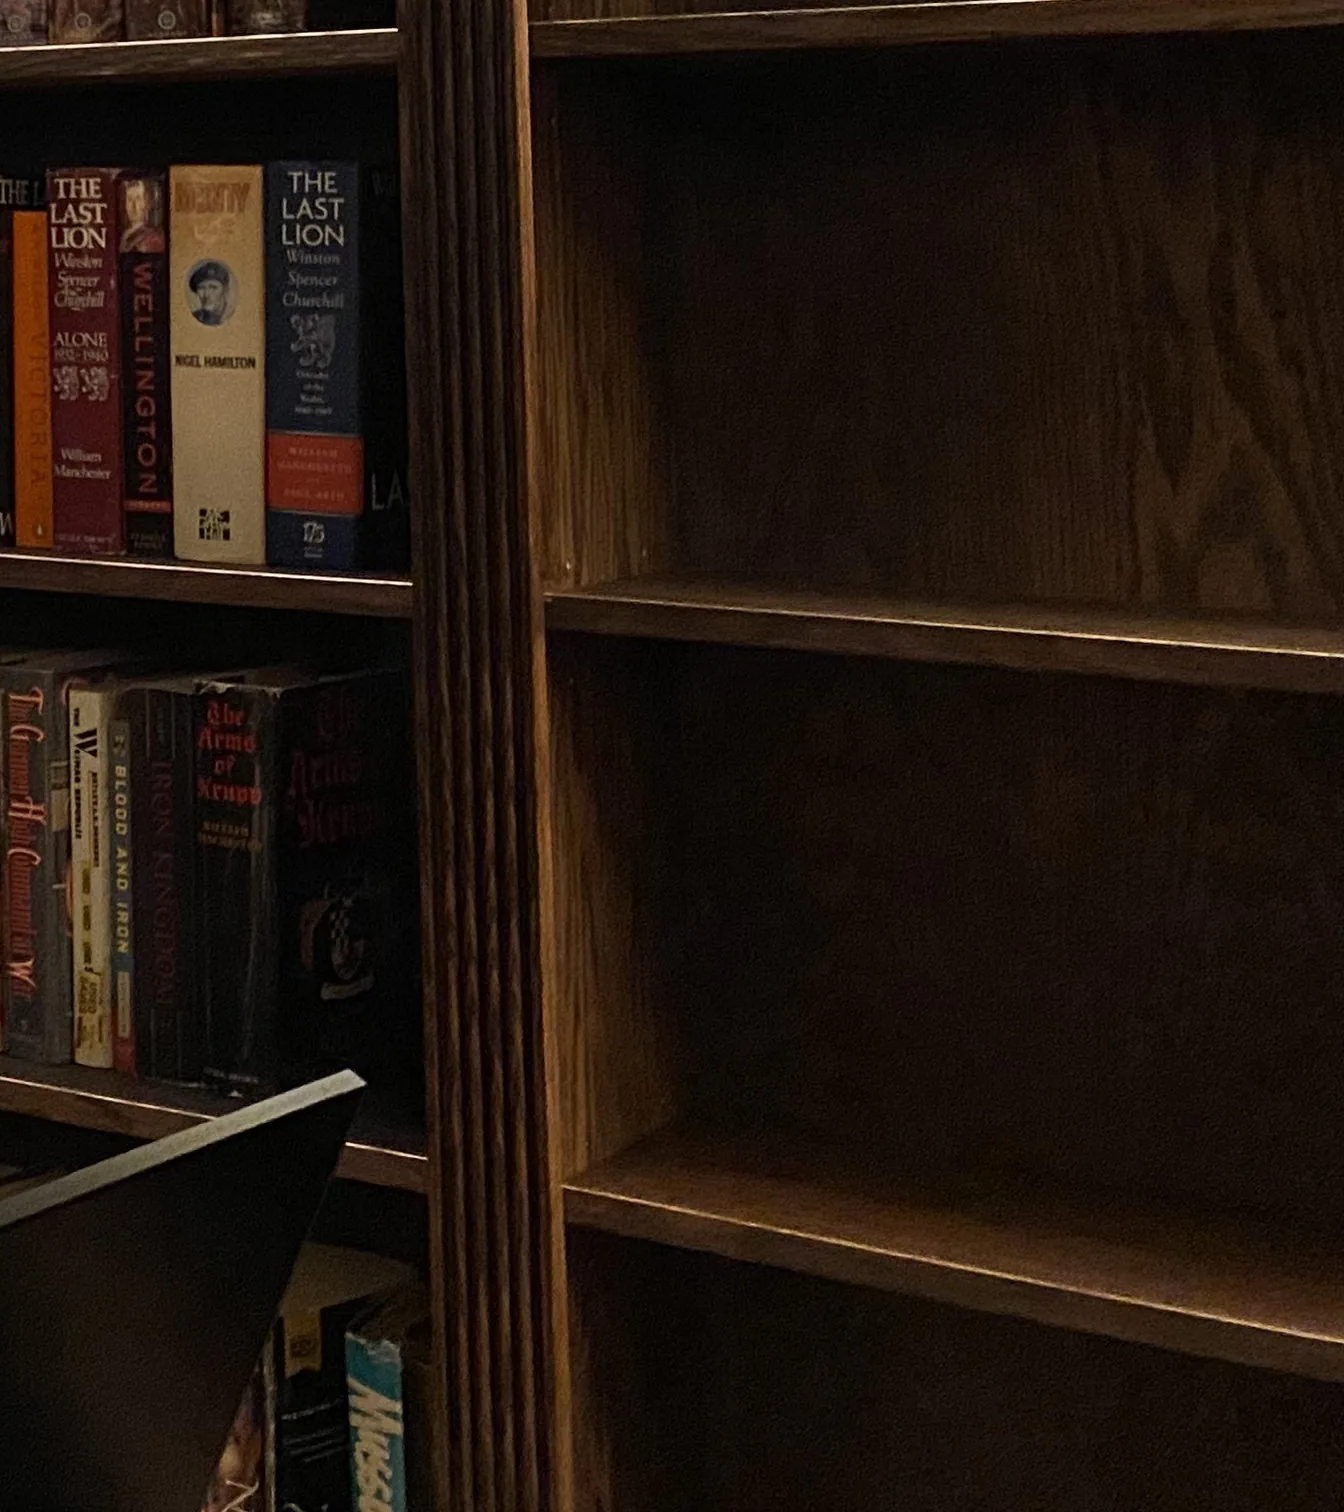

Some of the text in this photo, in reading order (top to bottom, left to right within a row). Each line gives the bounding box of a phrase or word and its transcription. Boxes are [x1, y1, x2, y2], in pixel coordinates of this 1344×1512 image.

[54, 177, 102, 200] THE
[287, 171, 338, 195] THE
[50, 201, 109, 225] LAST
[280, 197, 346, 222] LAST
[50, 226, 108, 250] LION
[280, 223, 346, 248] LION
[54, 252, 103, 270] Winston
[286, 249, 341, 266] Winston
[57, 272, 101, 290] Spencer
[287, 271, 339, 289] Spencer
[53, 290, 105, 310] Churchill
[282, 290, 346, 310] Churchill
[54, 331, 109, 349] ALONE
[174, 354, 257, 370] NIGEL HAMILTON
[132, 261, 158, 495] WELLINGTON
[60, 446, 103, 464] William
[53, 464, 112, 481] Manchester
[206, 699, 248, 727] The
[197, 726, 257, 754] Arms
[196, 774, 263, 807] Krupp
[115, 764, 130, 955] BLOOD AND IRON
[7, 846, 43, 933] Command
